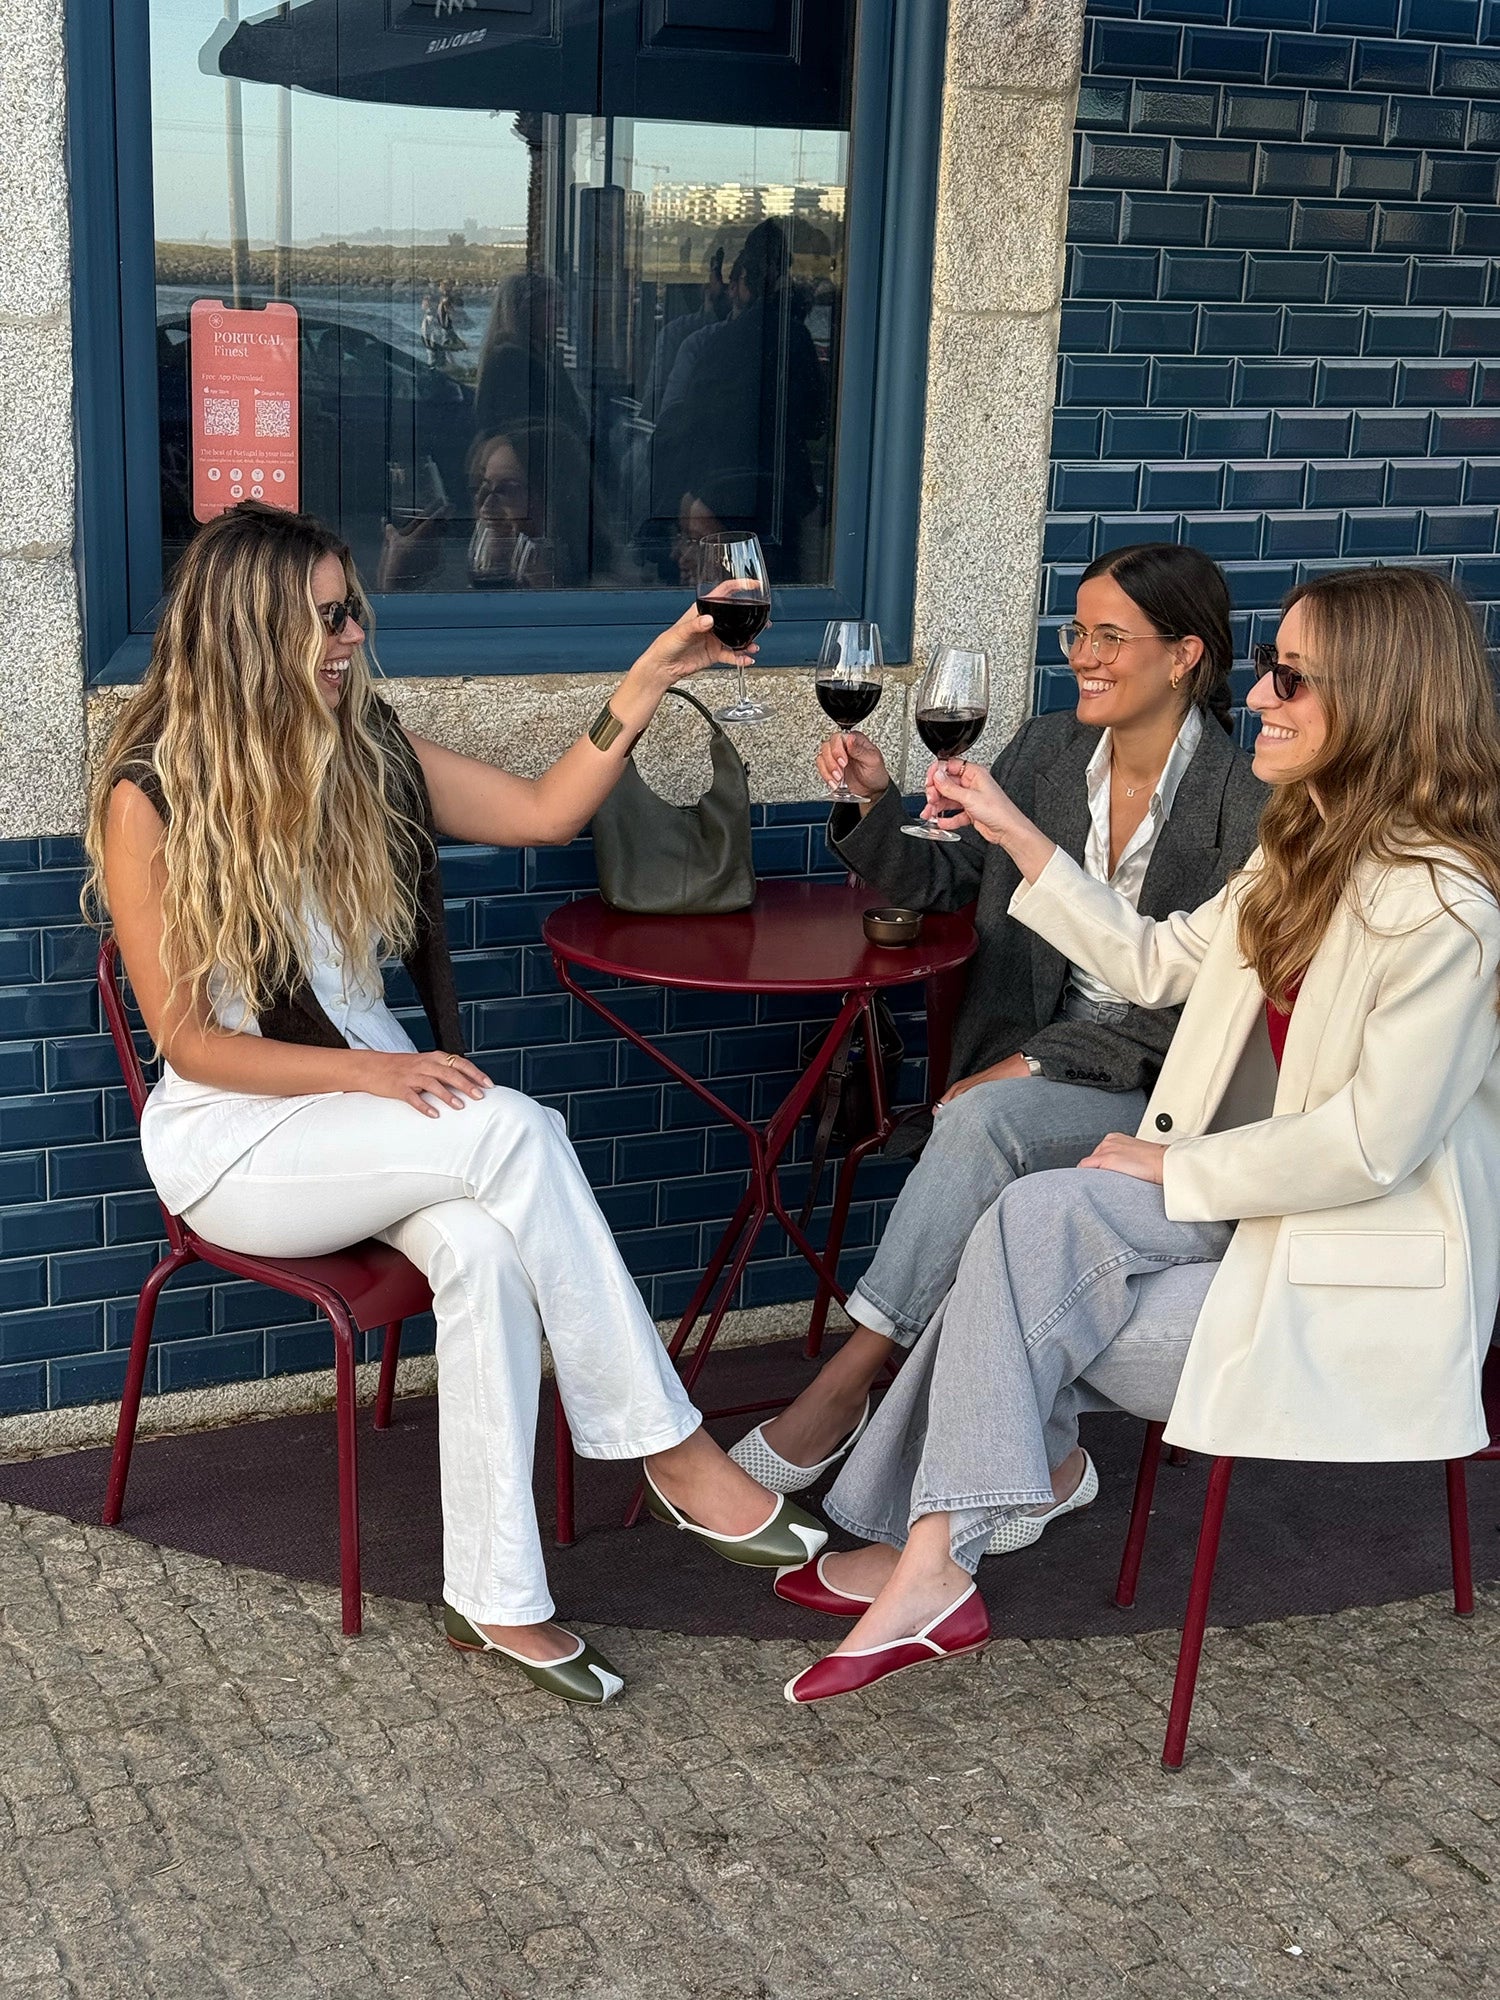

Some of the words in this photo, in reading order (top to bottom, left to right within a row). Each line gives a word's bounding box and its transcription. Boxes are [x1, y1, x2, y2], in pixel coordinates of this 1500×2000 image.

[214, 331, 284, 346] PORTUGAL
[214, 345, 248, 357] Finest
[202, 373, 216, 381] Free
[219, 374, 231, 382] App
[233, 449, 258, 458] Portugal
